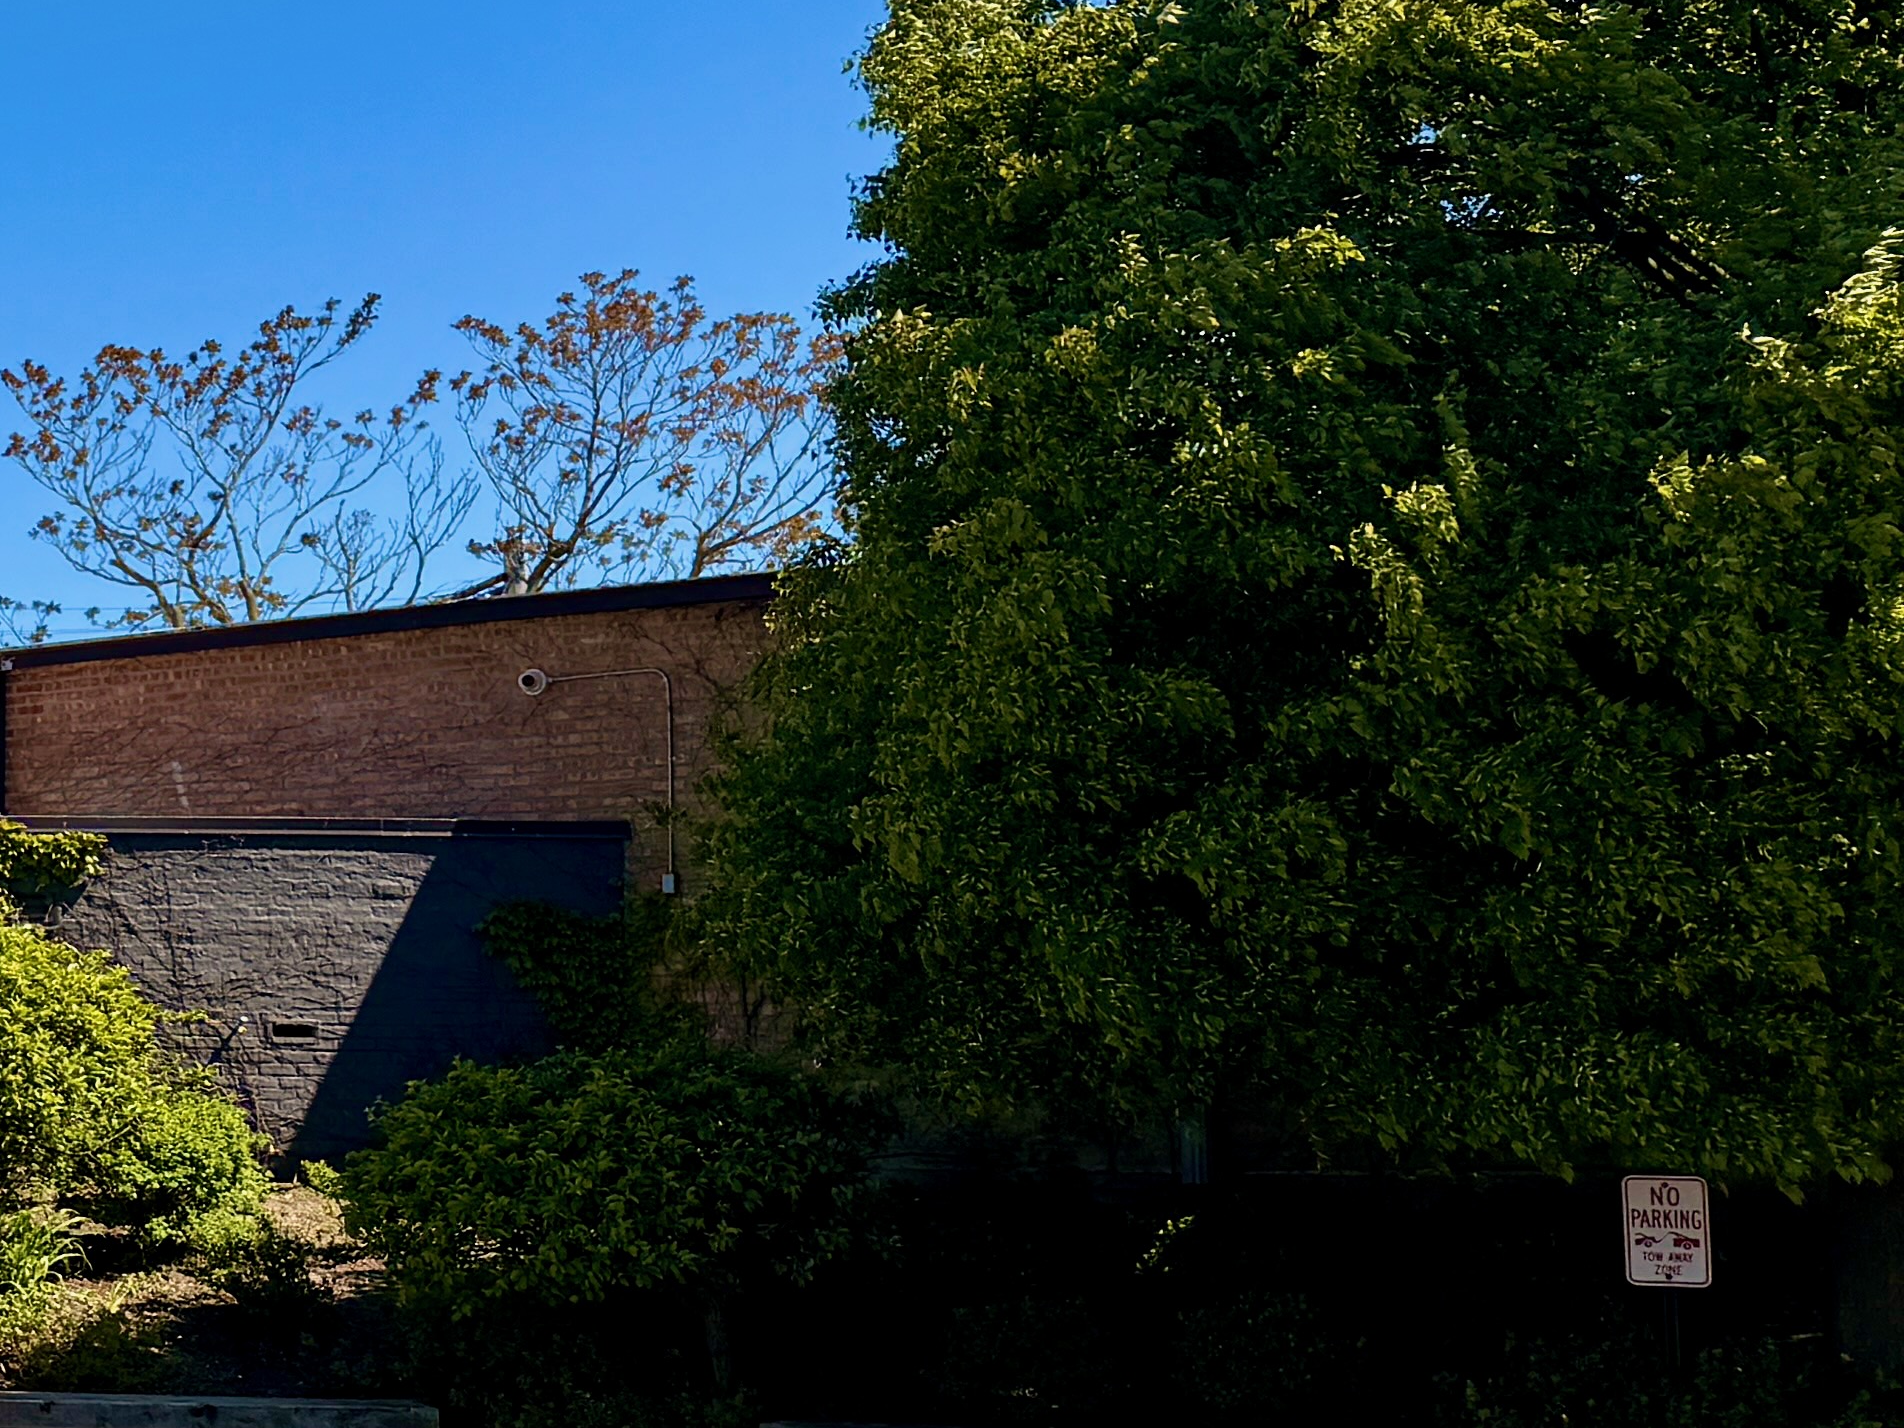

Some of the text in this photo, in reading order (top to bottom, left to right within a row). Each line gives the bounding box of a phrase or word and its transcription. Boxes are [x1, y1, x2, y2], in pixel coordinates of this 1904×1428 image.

[1650, 1186, 1680, 1206] NO
[1631, 1209, 1702, 1230] PARKING
[1643, 1251, 1694, 1263] TOW AWAY
[1655, 1264, 1683, 1276] ZONE
